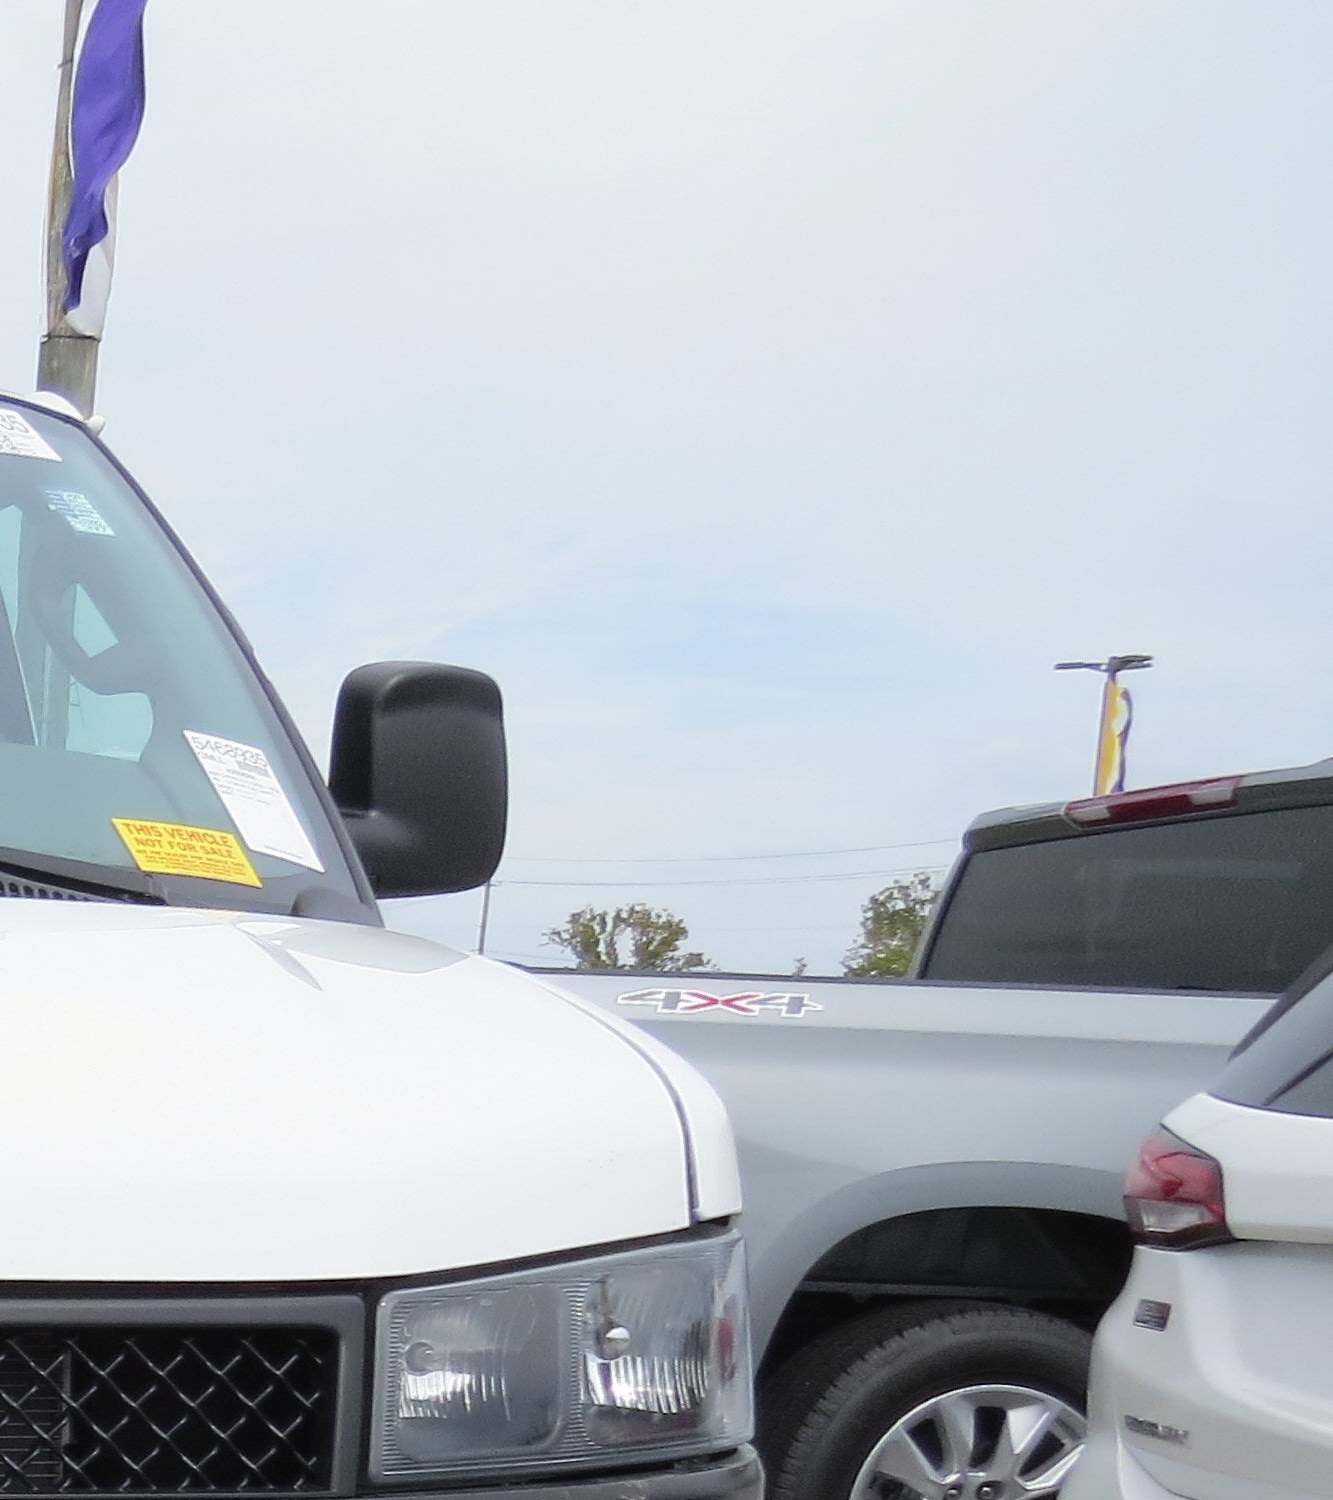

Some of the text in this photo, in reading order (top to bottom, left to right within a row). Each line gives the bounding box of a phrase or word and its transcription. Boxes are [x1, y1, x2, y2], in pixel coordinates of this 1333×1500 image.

[121, 822, 234, 849] THIS VEHICLE
[134, 837, 163, 849] NOT
[167, 841, 198, 853] FOR
[200, 845, 237, 859] SALE
